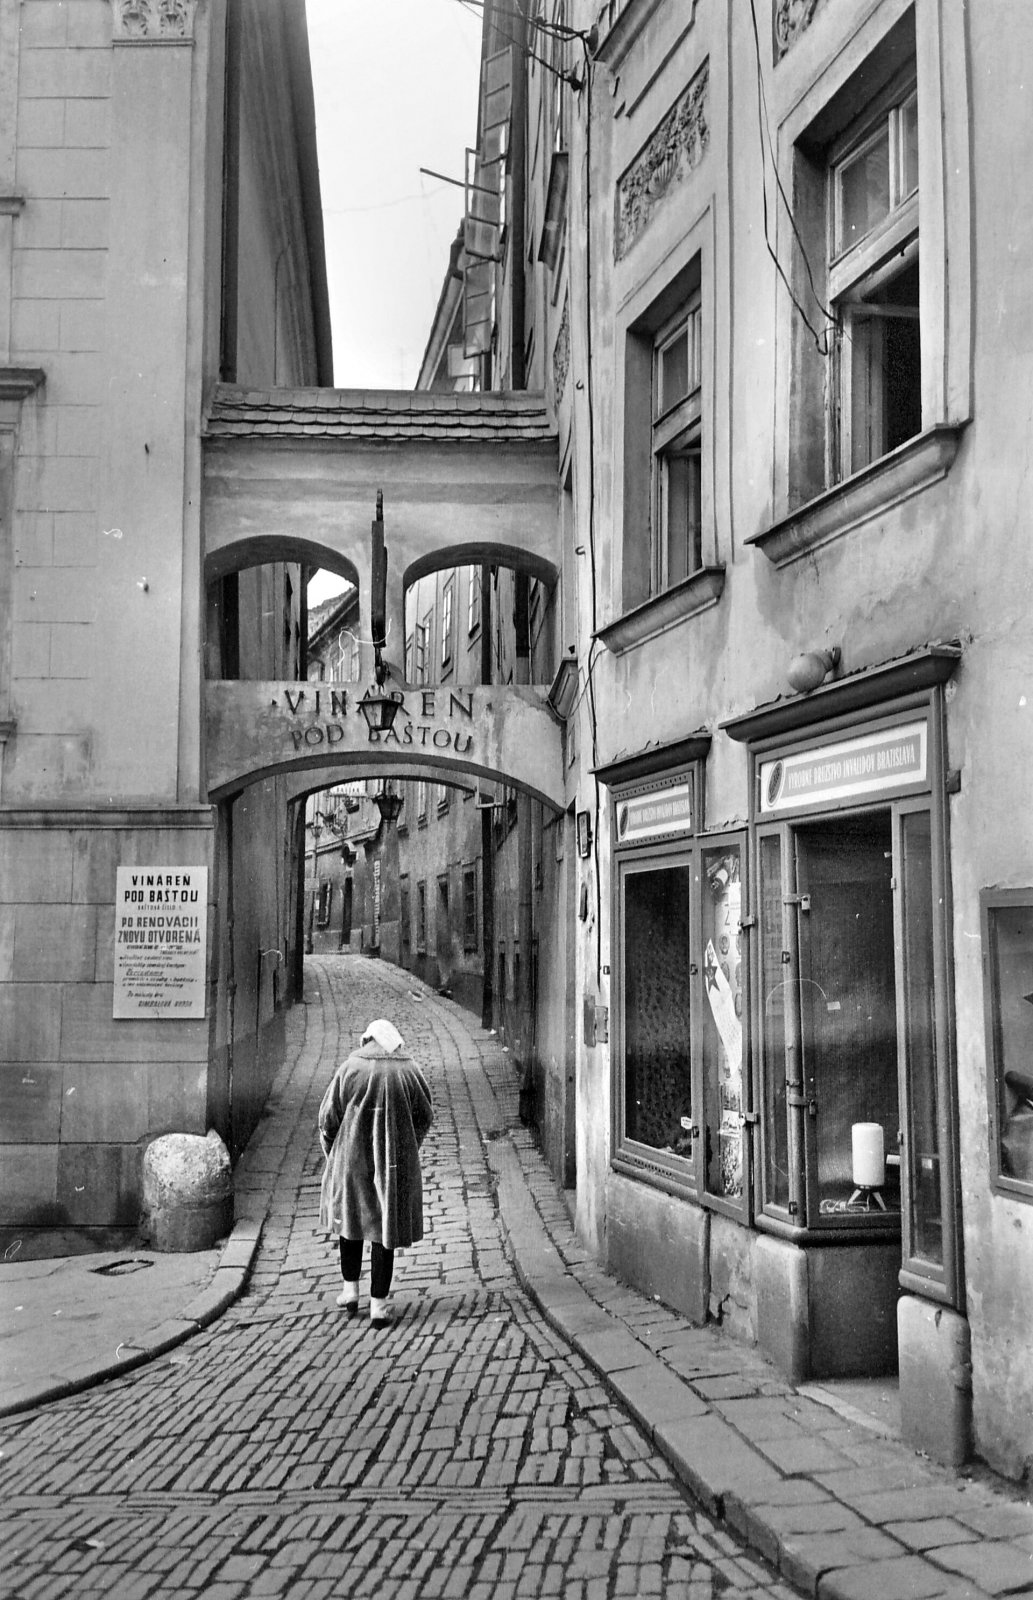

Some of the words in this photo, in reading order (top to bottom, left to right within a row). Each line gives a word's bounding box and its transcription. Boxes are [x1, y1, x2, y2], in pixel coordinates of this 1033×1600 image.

[291, 724, 345, 750] POD
[877, 743, 915, 771] BRATISLAVA
[124, 890, 144, 903] POD
[149, 888, 199, 903] BAŠTOU
[121, 916, 134, 928] PO
[117, 930, 146, 944] ZNOVU
[148, 928, 201, 944] OTVORENÁ
